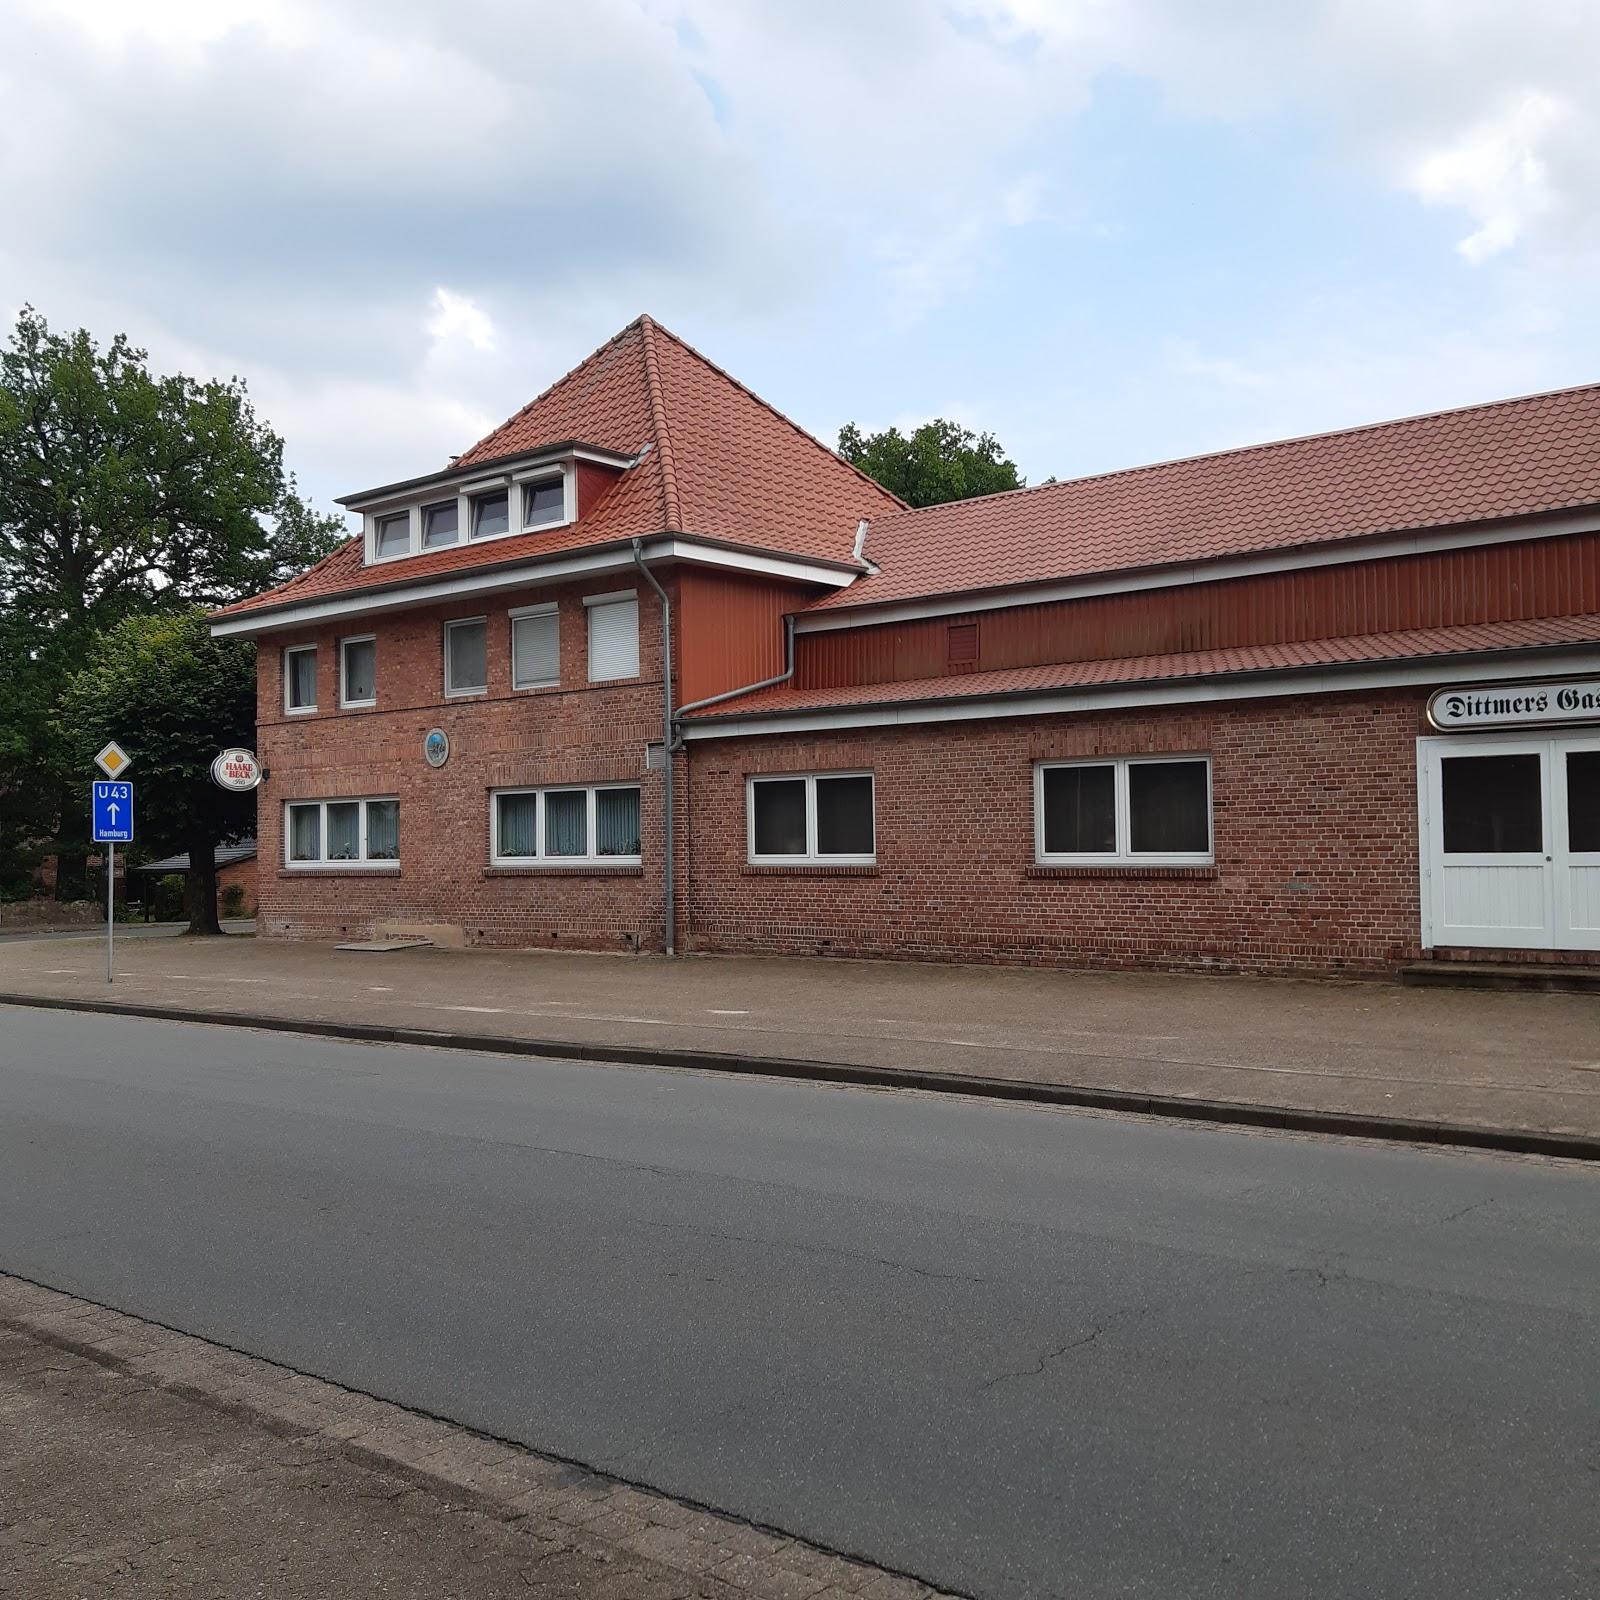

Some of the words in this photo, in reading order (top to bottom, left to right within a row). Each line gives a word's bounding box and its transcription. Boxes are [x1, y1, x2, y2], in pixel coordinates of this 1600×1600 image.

[1446, 691, 1548, 717] Dittmers
[225, 762, 253, 771] HAAKE
[228, 770, 251, 779] BECK
[99, 829, 128, 839] Hamburg
